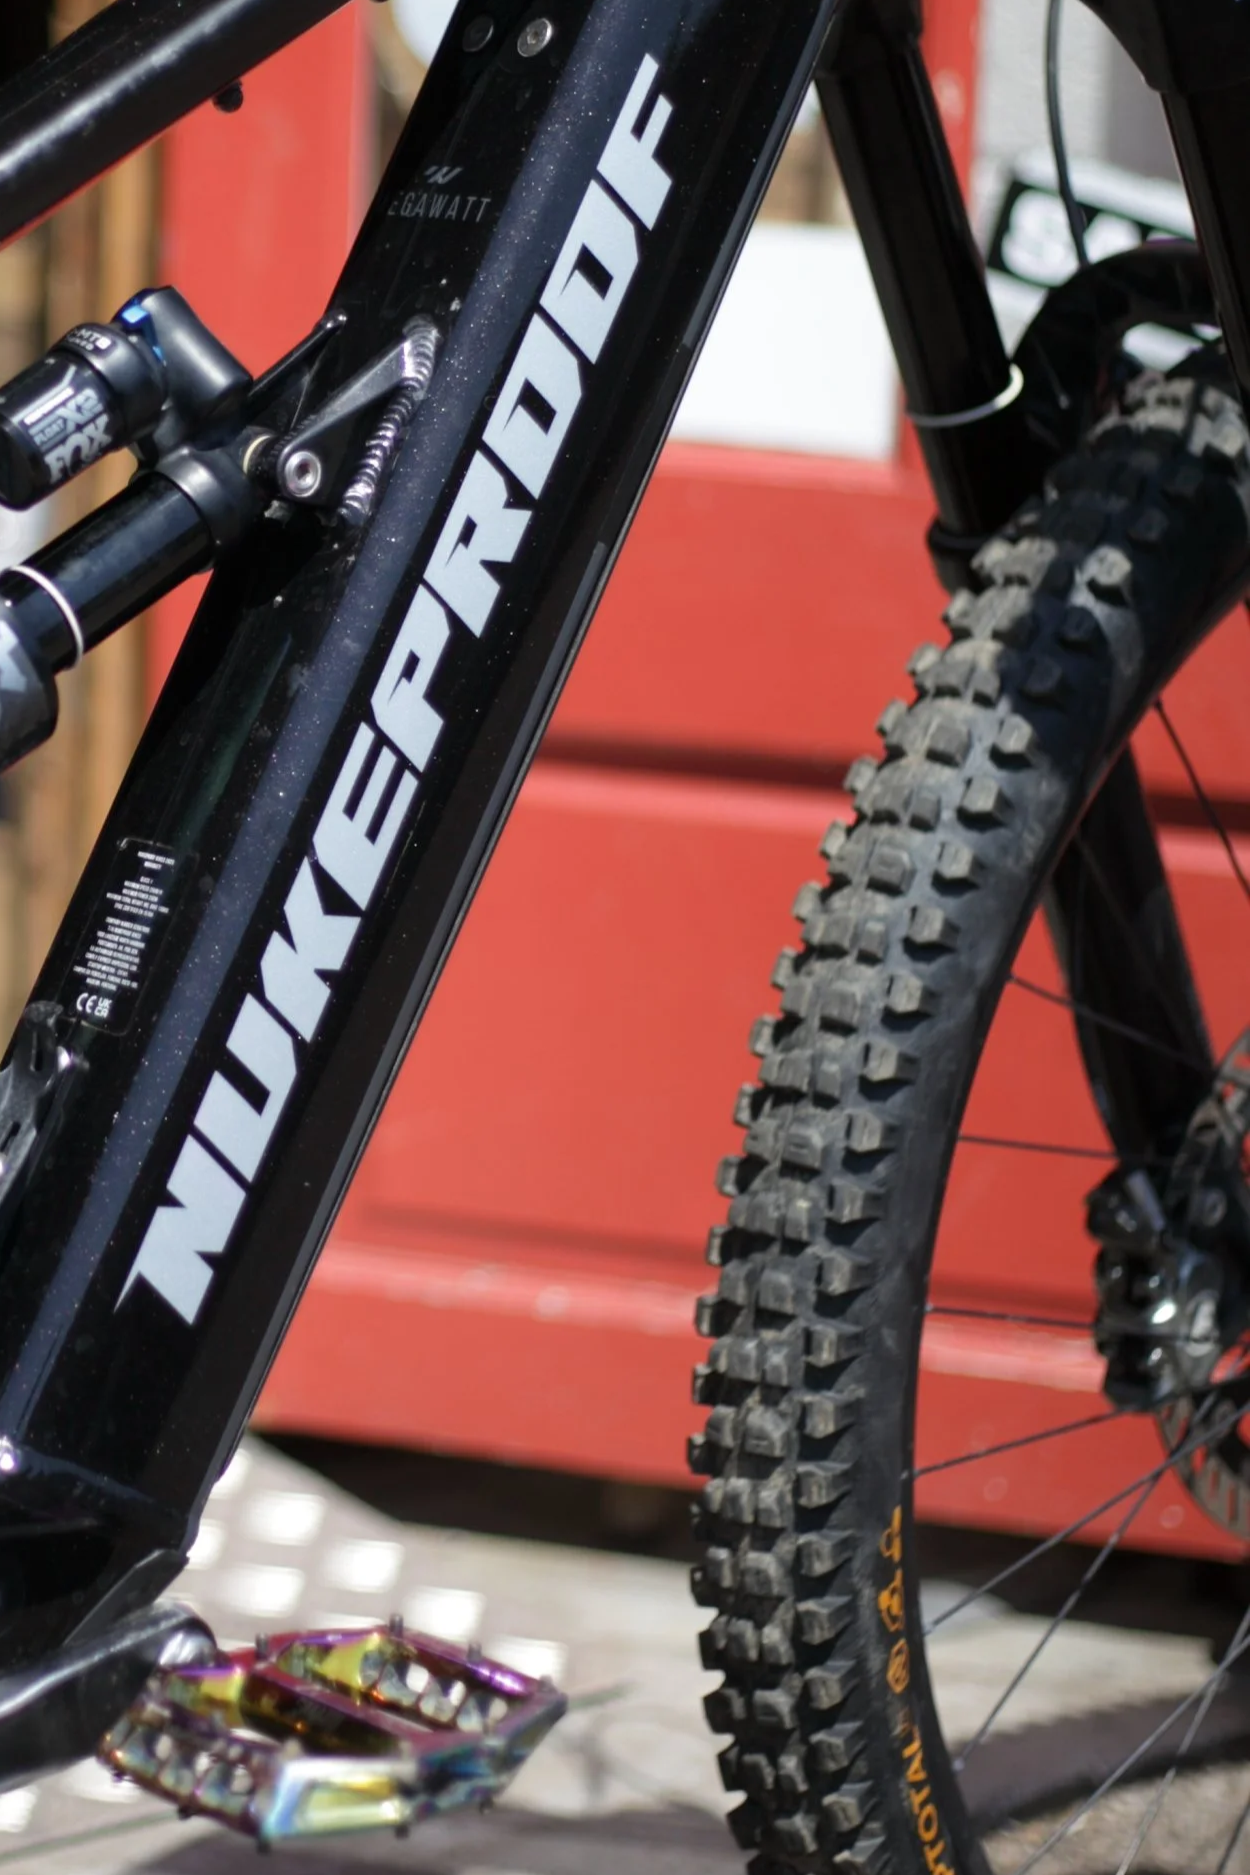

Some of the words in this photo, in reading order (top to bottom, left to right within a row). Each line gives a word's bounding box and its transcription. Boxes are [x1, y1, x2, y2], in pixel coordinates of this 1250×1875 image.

[388, 190, 492, 222] EGAWATT
[43, 413, 112, 485] FOX
[114, 53, 675, 1326] NUKEPROOF
